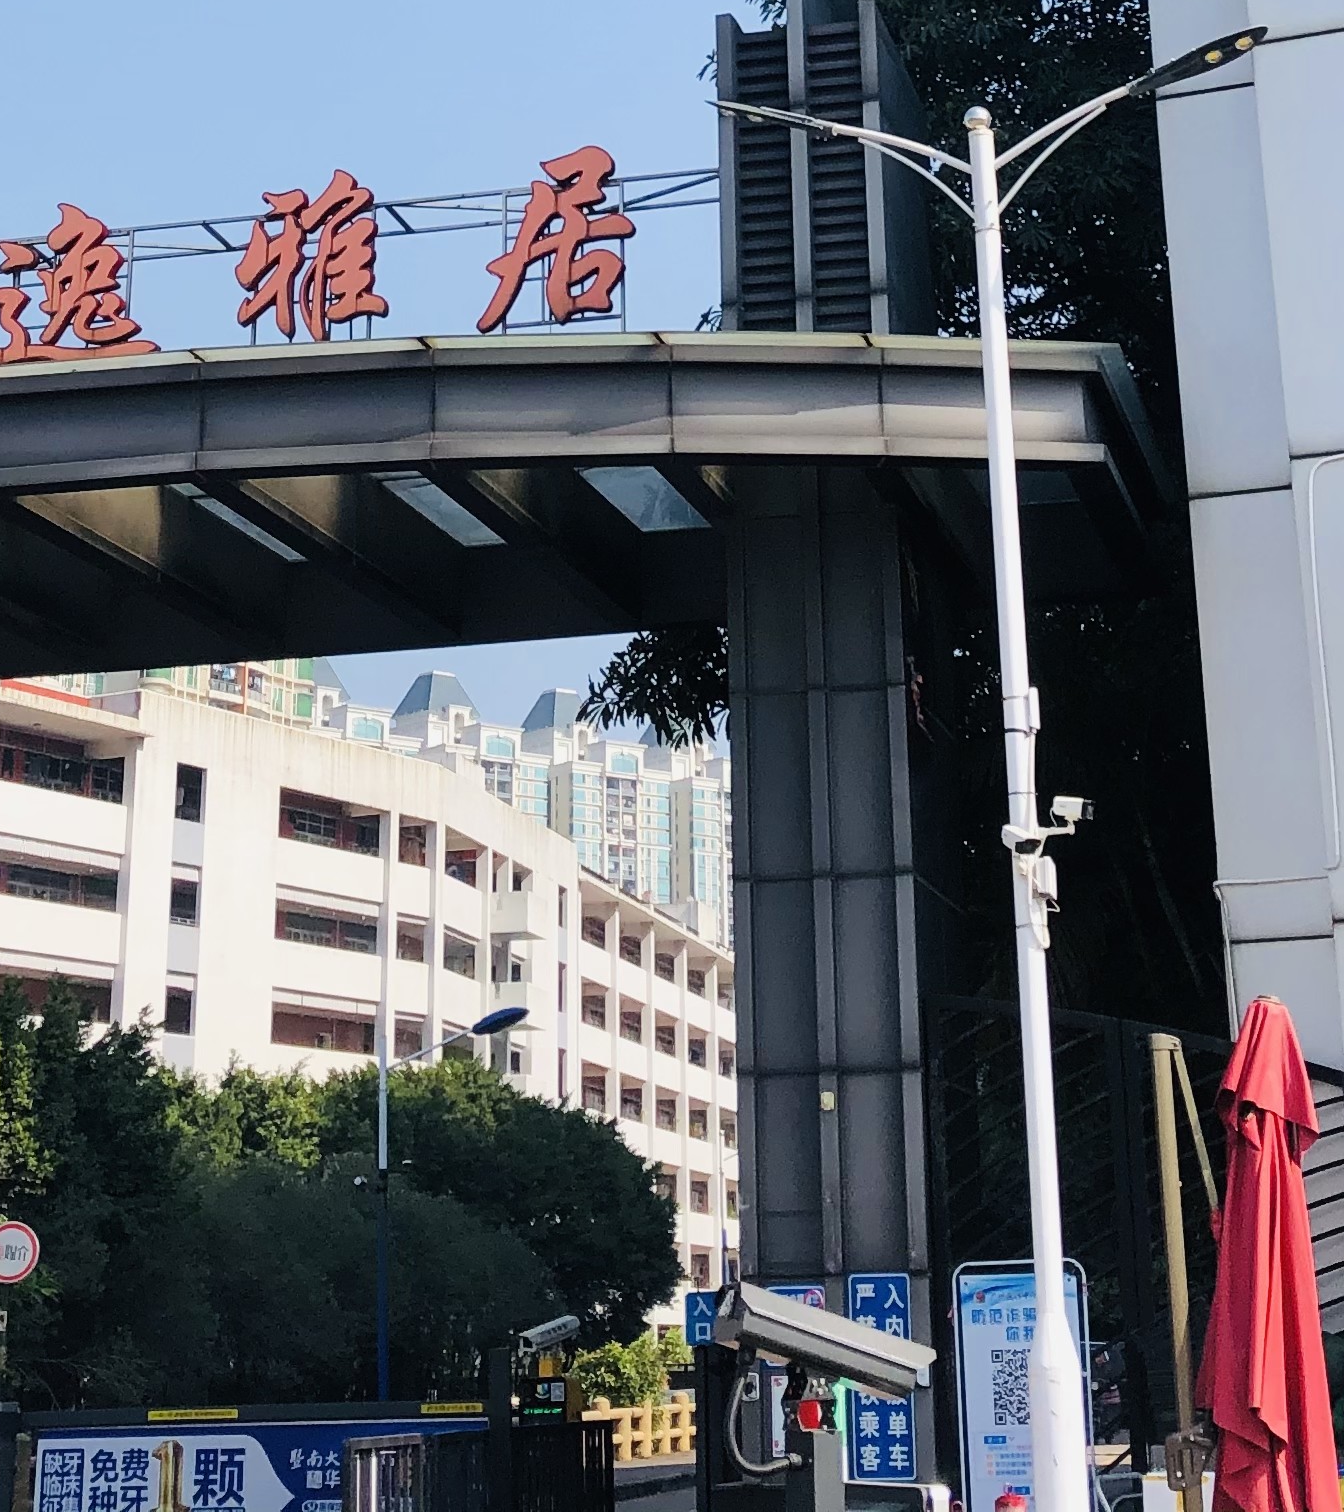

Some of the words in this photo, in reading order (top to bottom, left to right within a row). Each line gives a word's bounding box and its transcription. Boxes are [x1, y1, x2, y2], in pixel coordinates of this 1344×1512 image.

[693, 1296, 713, 1341] 入口
[44, 1452, 82, 1474] 缺牙
[90, 1448, 150, 1483] 免费
[151, 1440, 191, 1512] 1
[193, 1448, 246, 1506] 颗
[43, 1475, 81, 1496] 临床
[88, 1485, 149, 1512] 种牙
